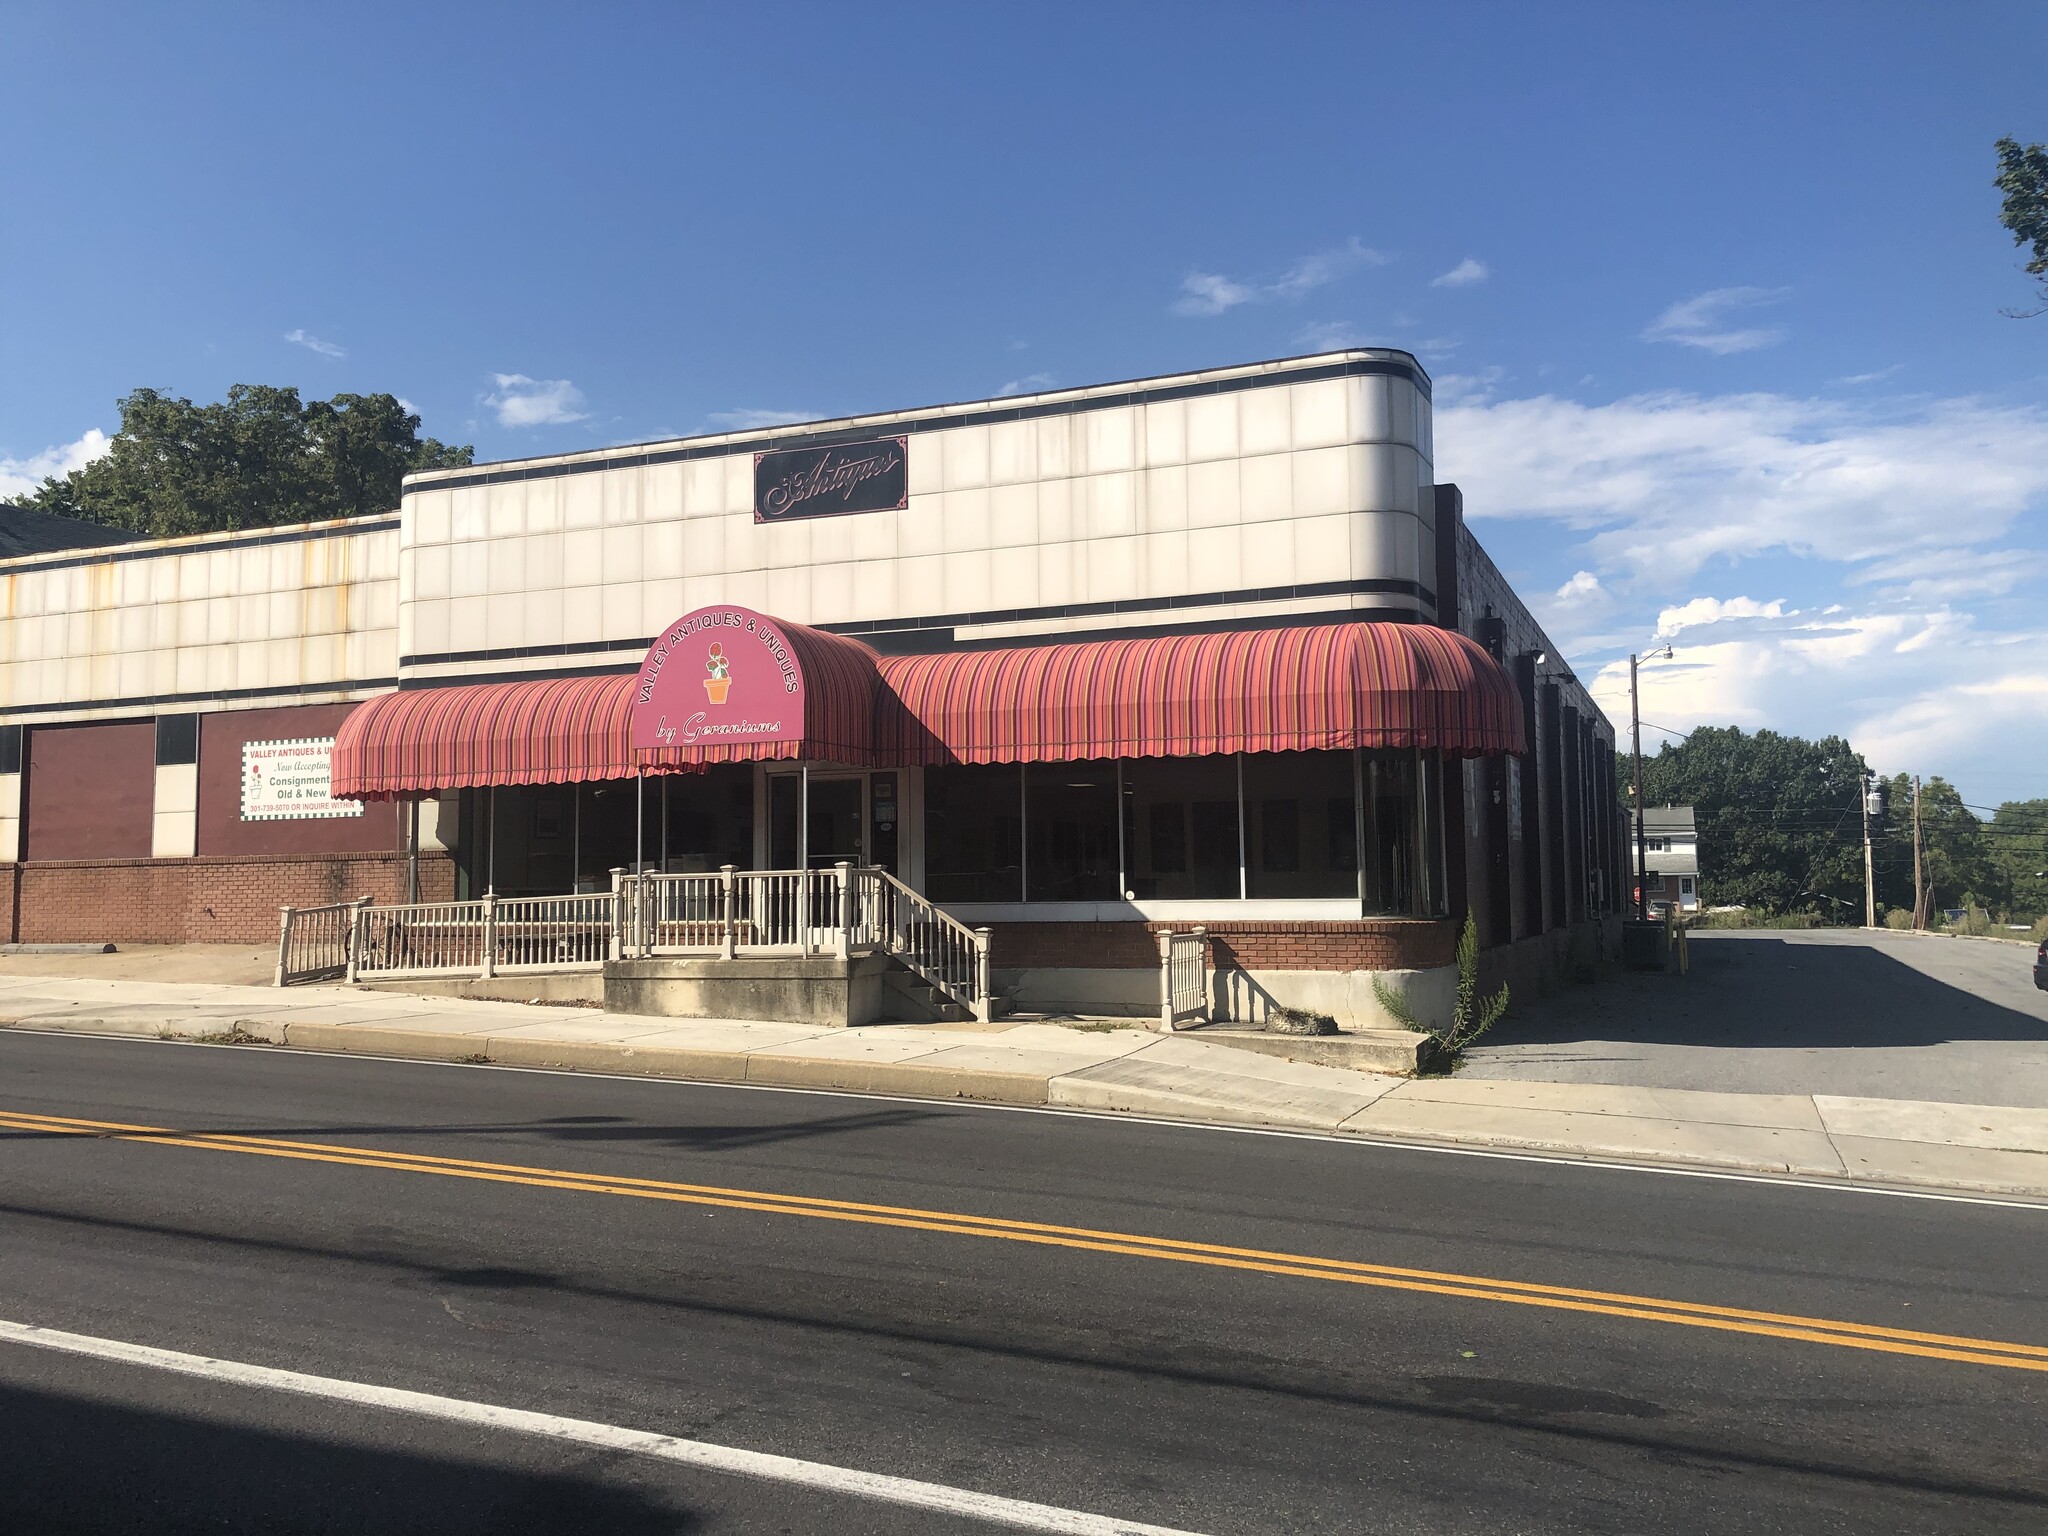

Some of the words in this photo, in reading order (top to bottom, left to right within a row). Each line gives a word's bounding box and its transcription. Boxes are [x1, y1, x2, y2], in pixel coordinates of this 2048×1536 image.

[638, 644, 670, 704] VALLEY
[670, 612, 742, 647] ANTIQUES
[746, 618, 756, 633] &
[758, 626, 799, 693] UNIQUES
[656, 716, 676, 744] by
[683, 711, 781, 743] Geraniums
[250, 749, 277, 758] VALLEY
[278, 748, 315, 757] ANTIQUES
[316, 747, 322, 755] &
[277, 790, 293, 799] Old
[295, 790, 303, 798] &
[305, 788, 327, 798] New
[250, 804, 290, 813] 301-739-5070
[291, 803, 301, 811] OR
[302, 802, 330, 811] INQUIRE
